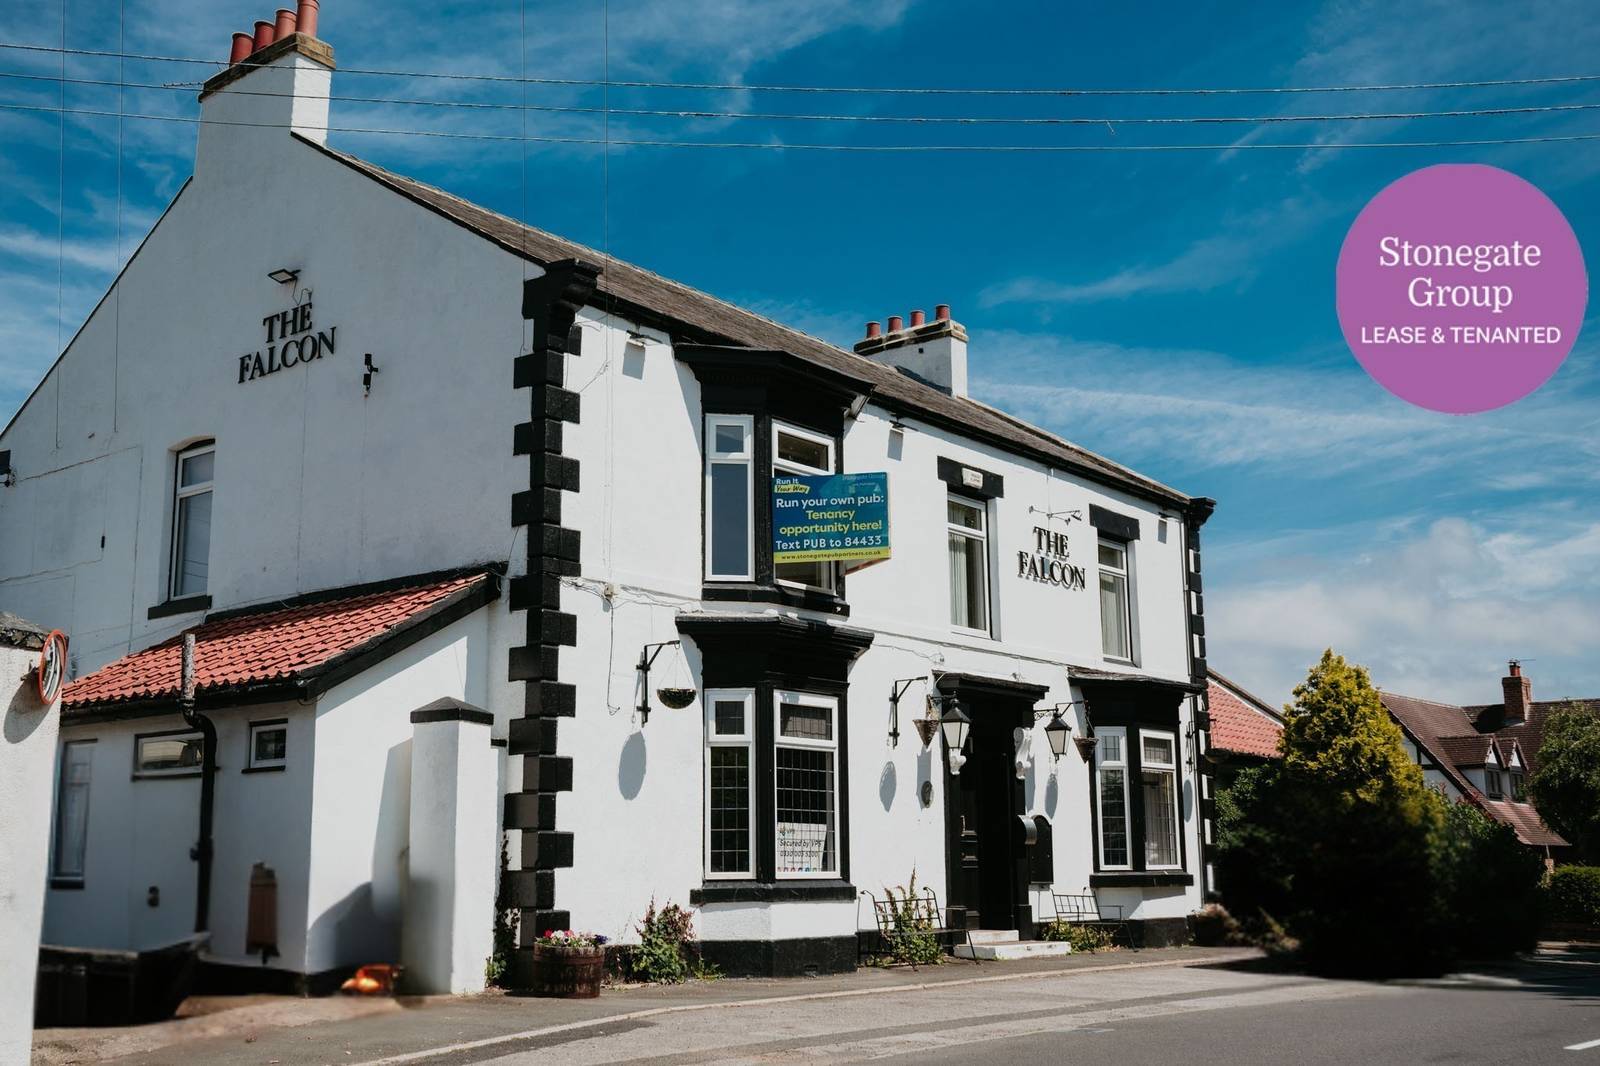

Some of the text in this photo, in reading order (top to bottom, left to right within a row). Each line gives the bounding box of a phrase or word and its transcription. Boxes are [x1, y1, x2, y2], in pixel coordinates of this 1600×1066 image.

[262, 302, 313, 344] THE
[238, 326, 337, 384] FALCON
[792, 485, 808, 494] Way
[776, 494, 885, 509] Run your own pub:
[805, 510, 856, 520] Tenancy
[779, 520, 882, 537] opportunity here!
[776, 535, 882, 550] Text PUB to 84433
[1033, 526, 1070, 559] THE
[1017, 550, 1086, 590] FALCON
[803, 840, 809, 848] by
